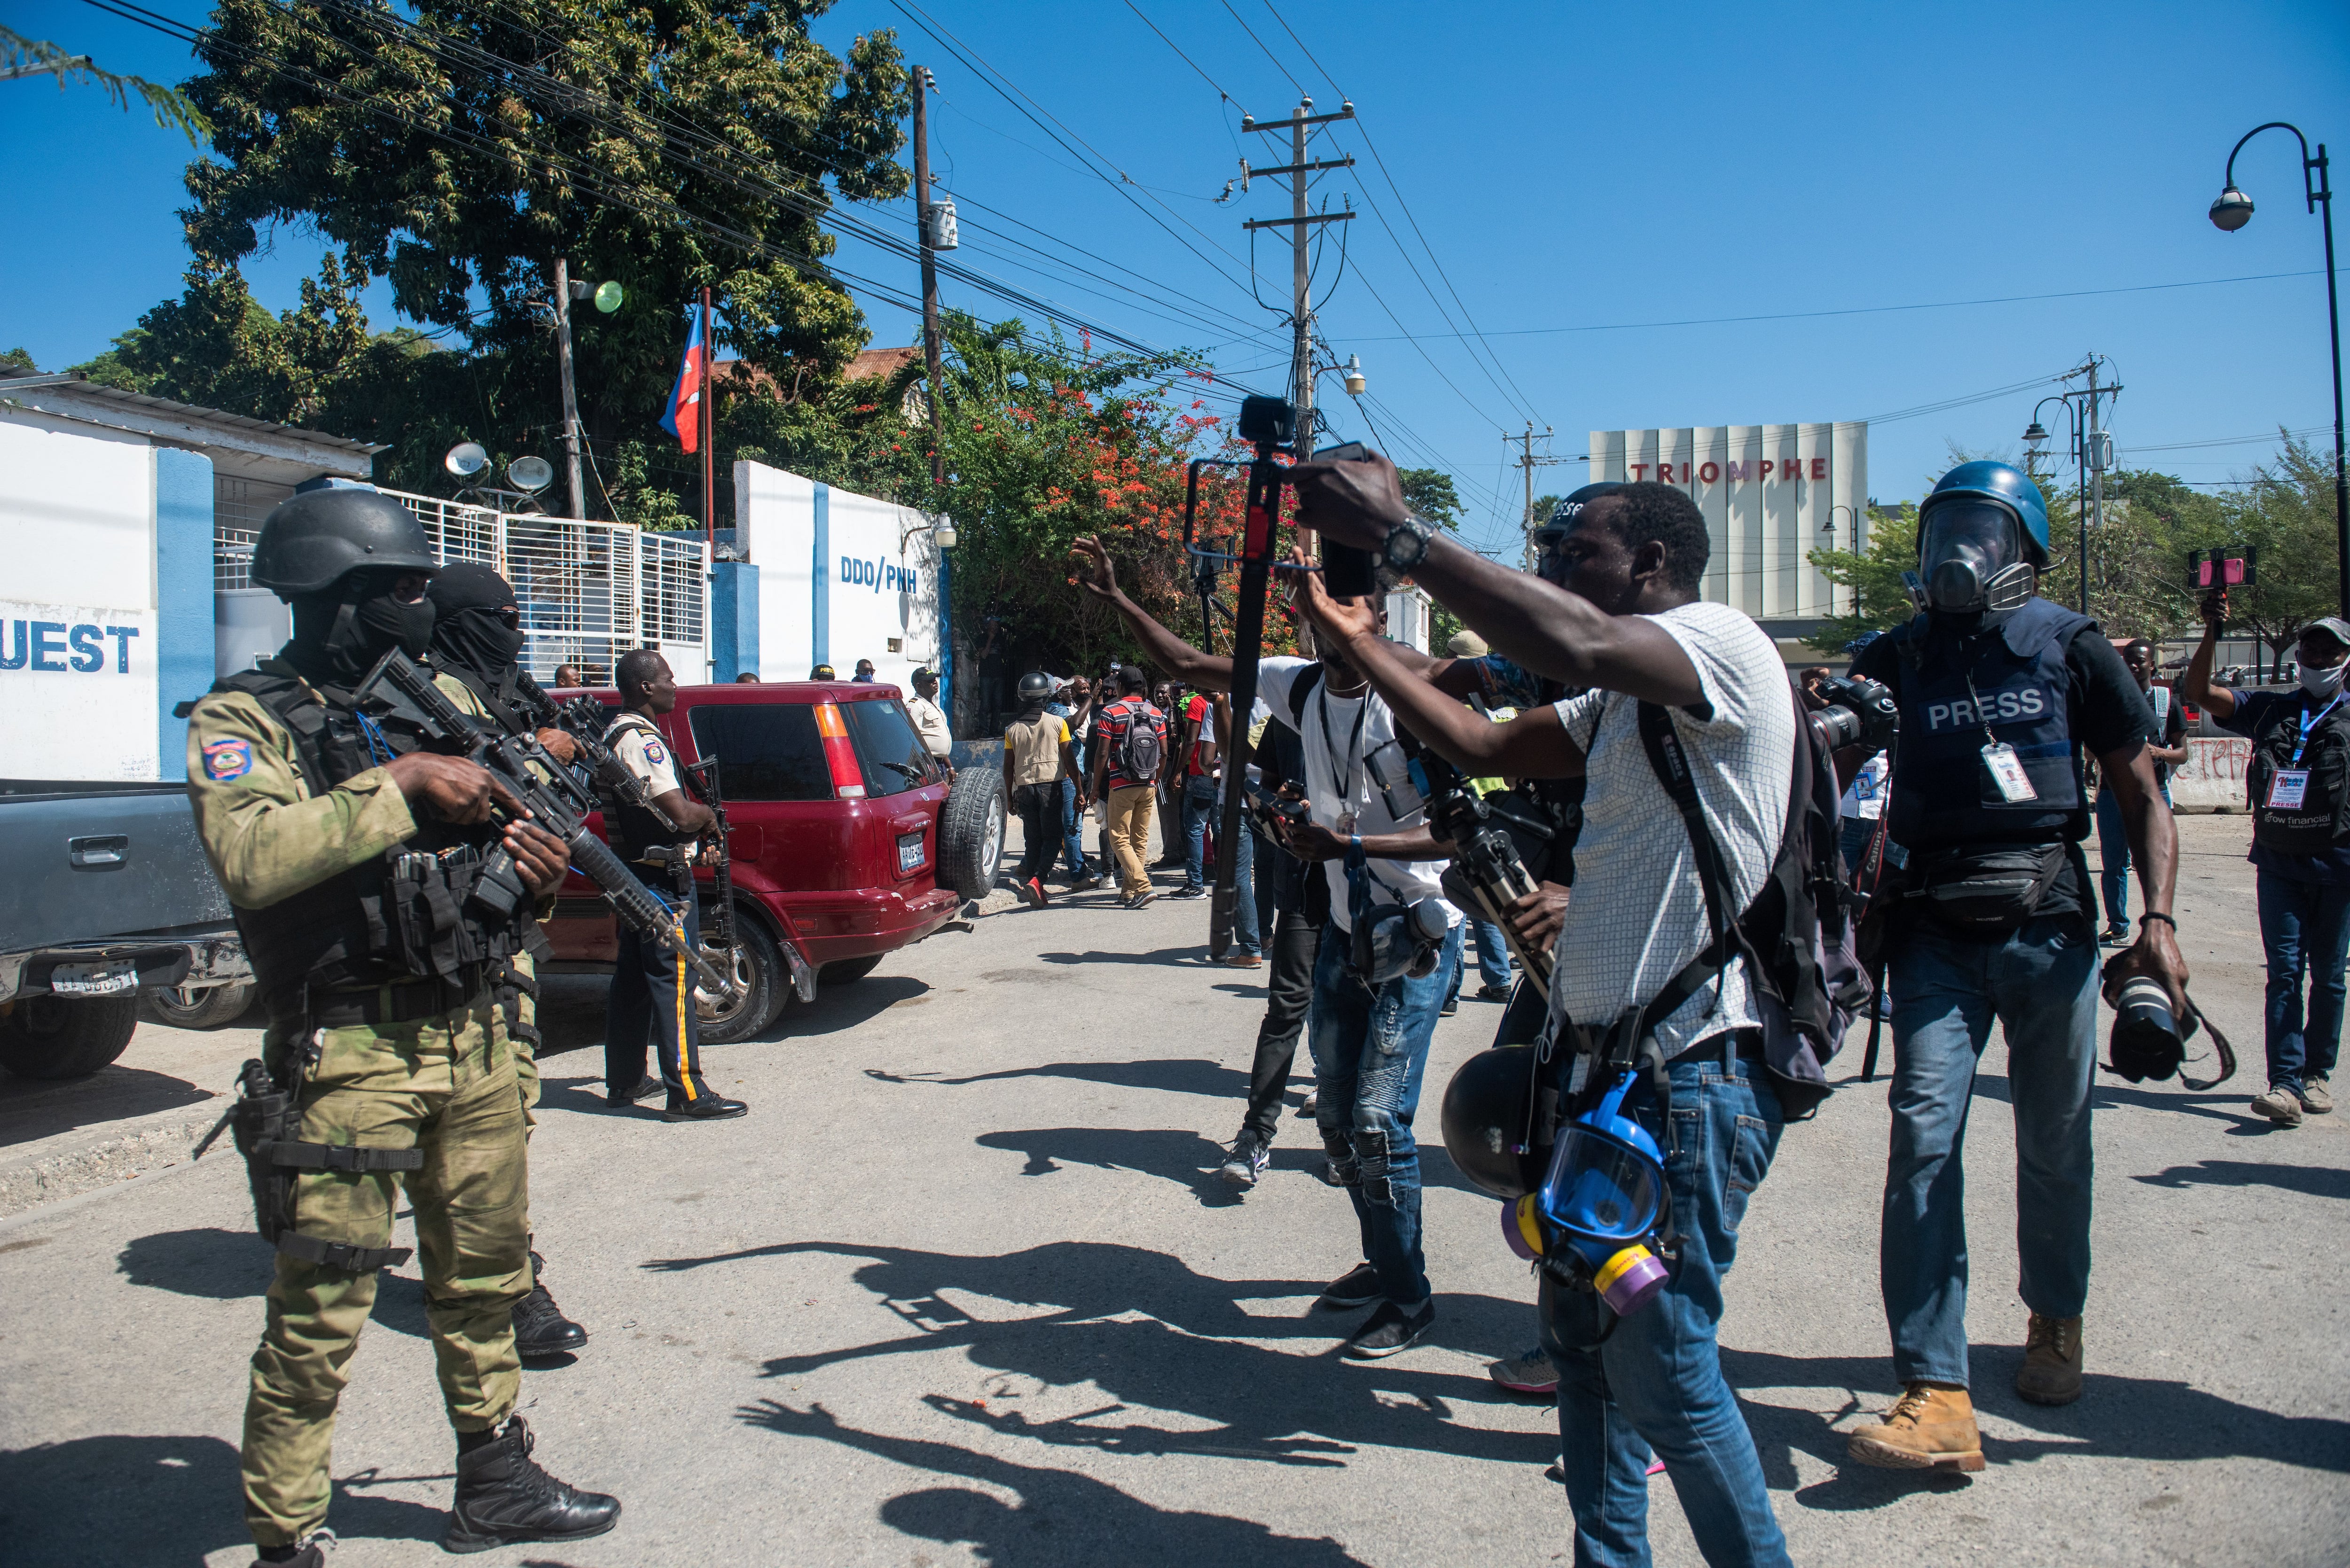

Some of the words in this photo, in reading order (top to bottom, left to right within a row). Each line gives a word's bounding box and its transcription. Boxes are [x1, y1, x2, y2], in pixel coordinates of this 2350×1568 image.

[1630, 458, 1826, 484] TRIOMPHE
[841, 555, 916, 594] DDO/PNH
[1928, 688, 2044, 730] PRESS
[2264, 813, 2286, 824] grow
[2287, 813, 2331, 825] financial
[1866, 831, 1882, 873] Canon
